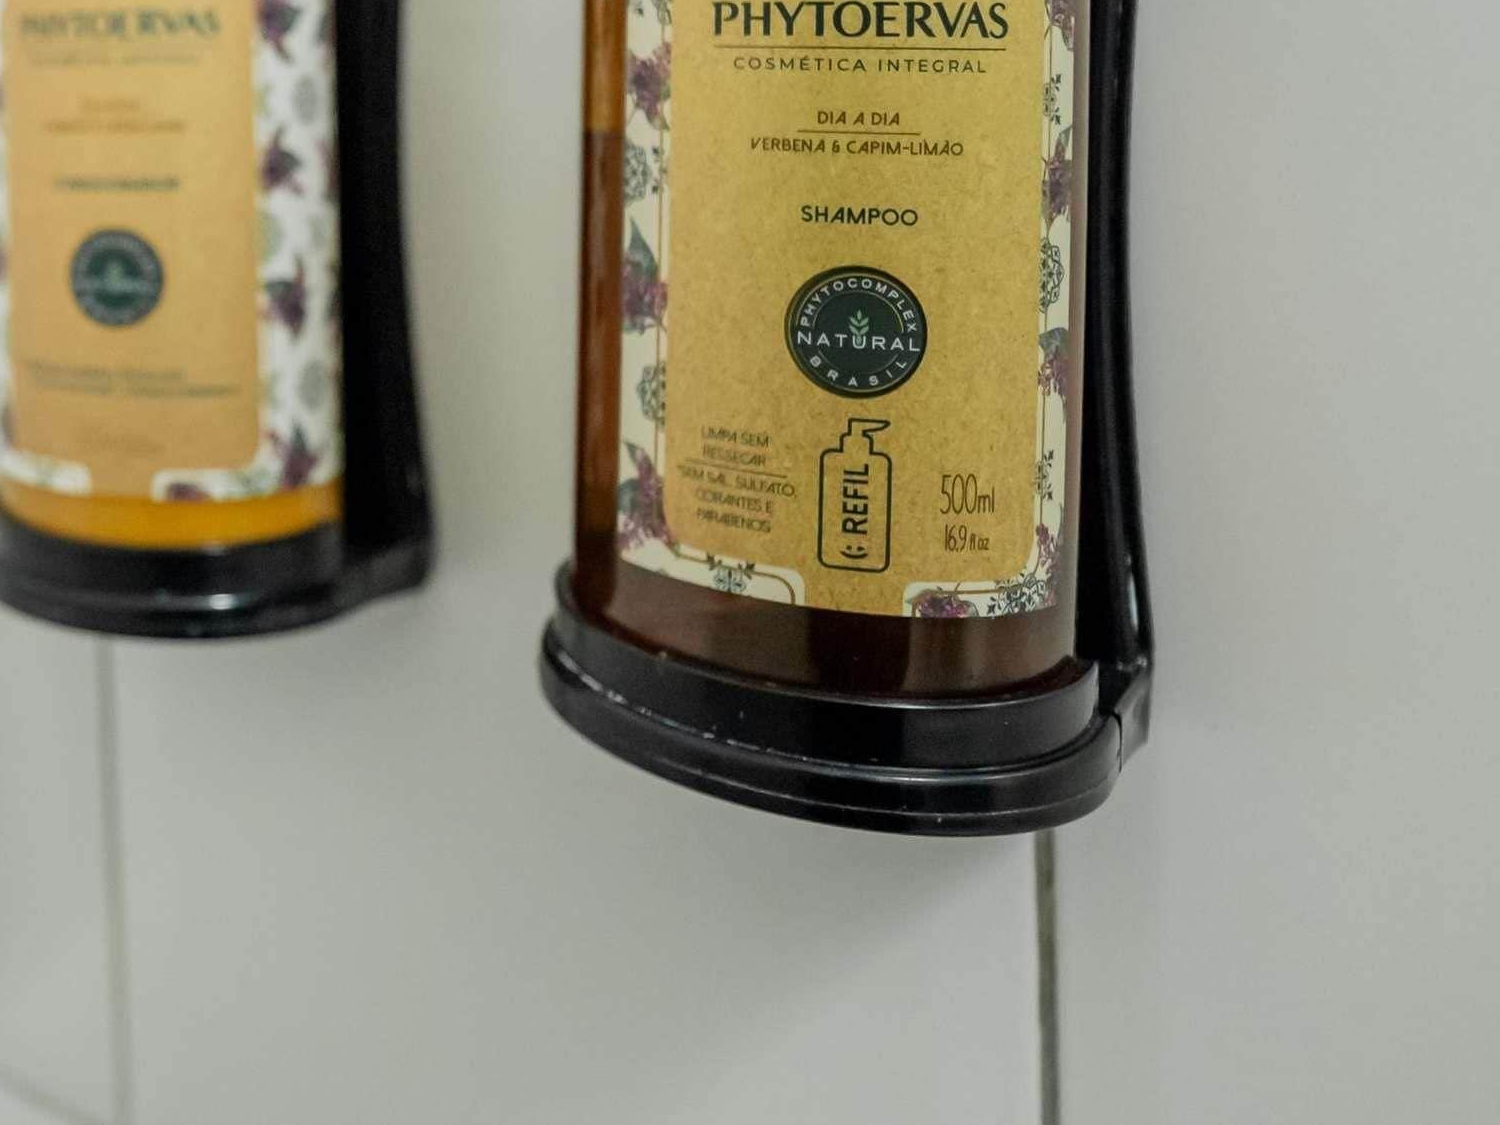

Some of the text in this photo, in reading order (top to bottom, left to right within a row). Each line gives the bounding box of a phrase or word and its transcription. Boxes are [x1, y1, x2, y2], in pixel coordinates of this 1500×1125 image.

[712, 0, 1009, 39] PHYTOERVAS
[733, 55, 987, 74] COSMÉTICA INTEGRAL
[816, 110, 901, 127] DIA A DIA
[750, 136, 965, 157] VERBENA & CAPIM-LIMÃO
[800, 204, 919, 227] SHAMPOO
[800, 277, 918, 333] PHYTOCOMPLEX
[797, 331, 921, 352] NATURAL
[809, 355, 908, 388] BRASIL
[841, 463, 870, 536] REFIL
